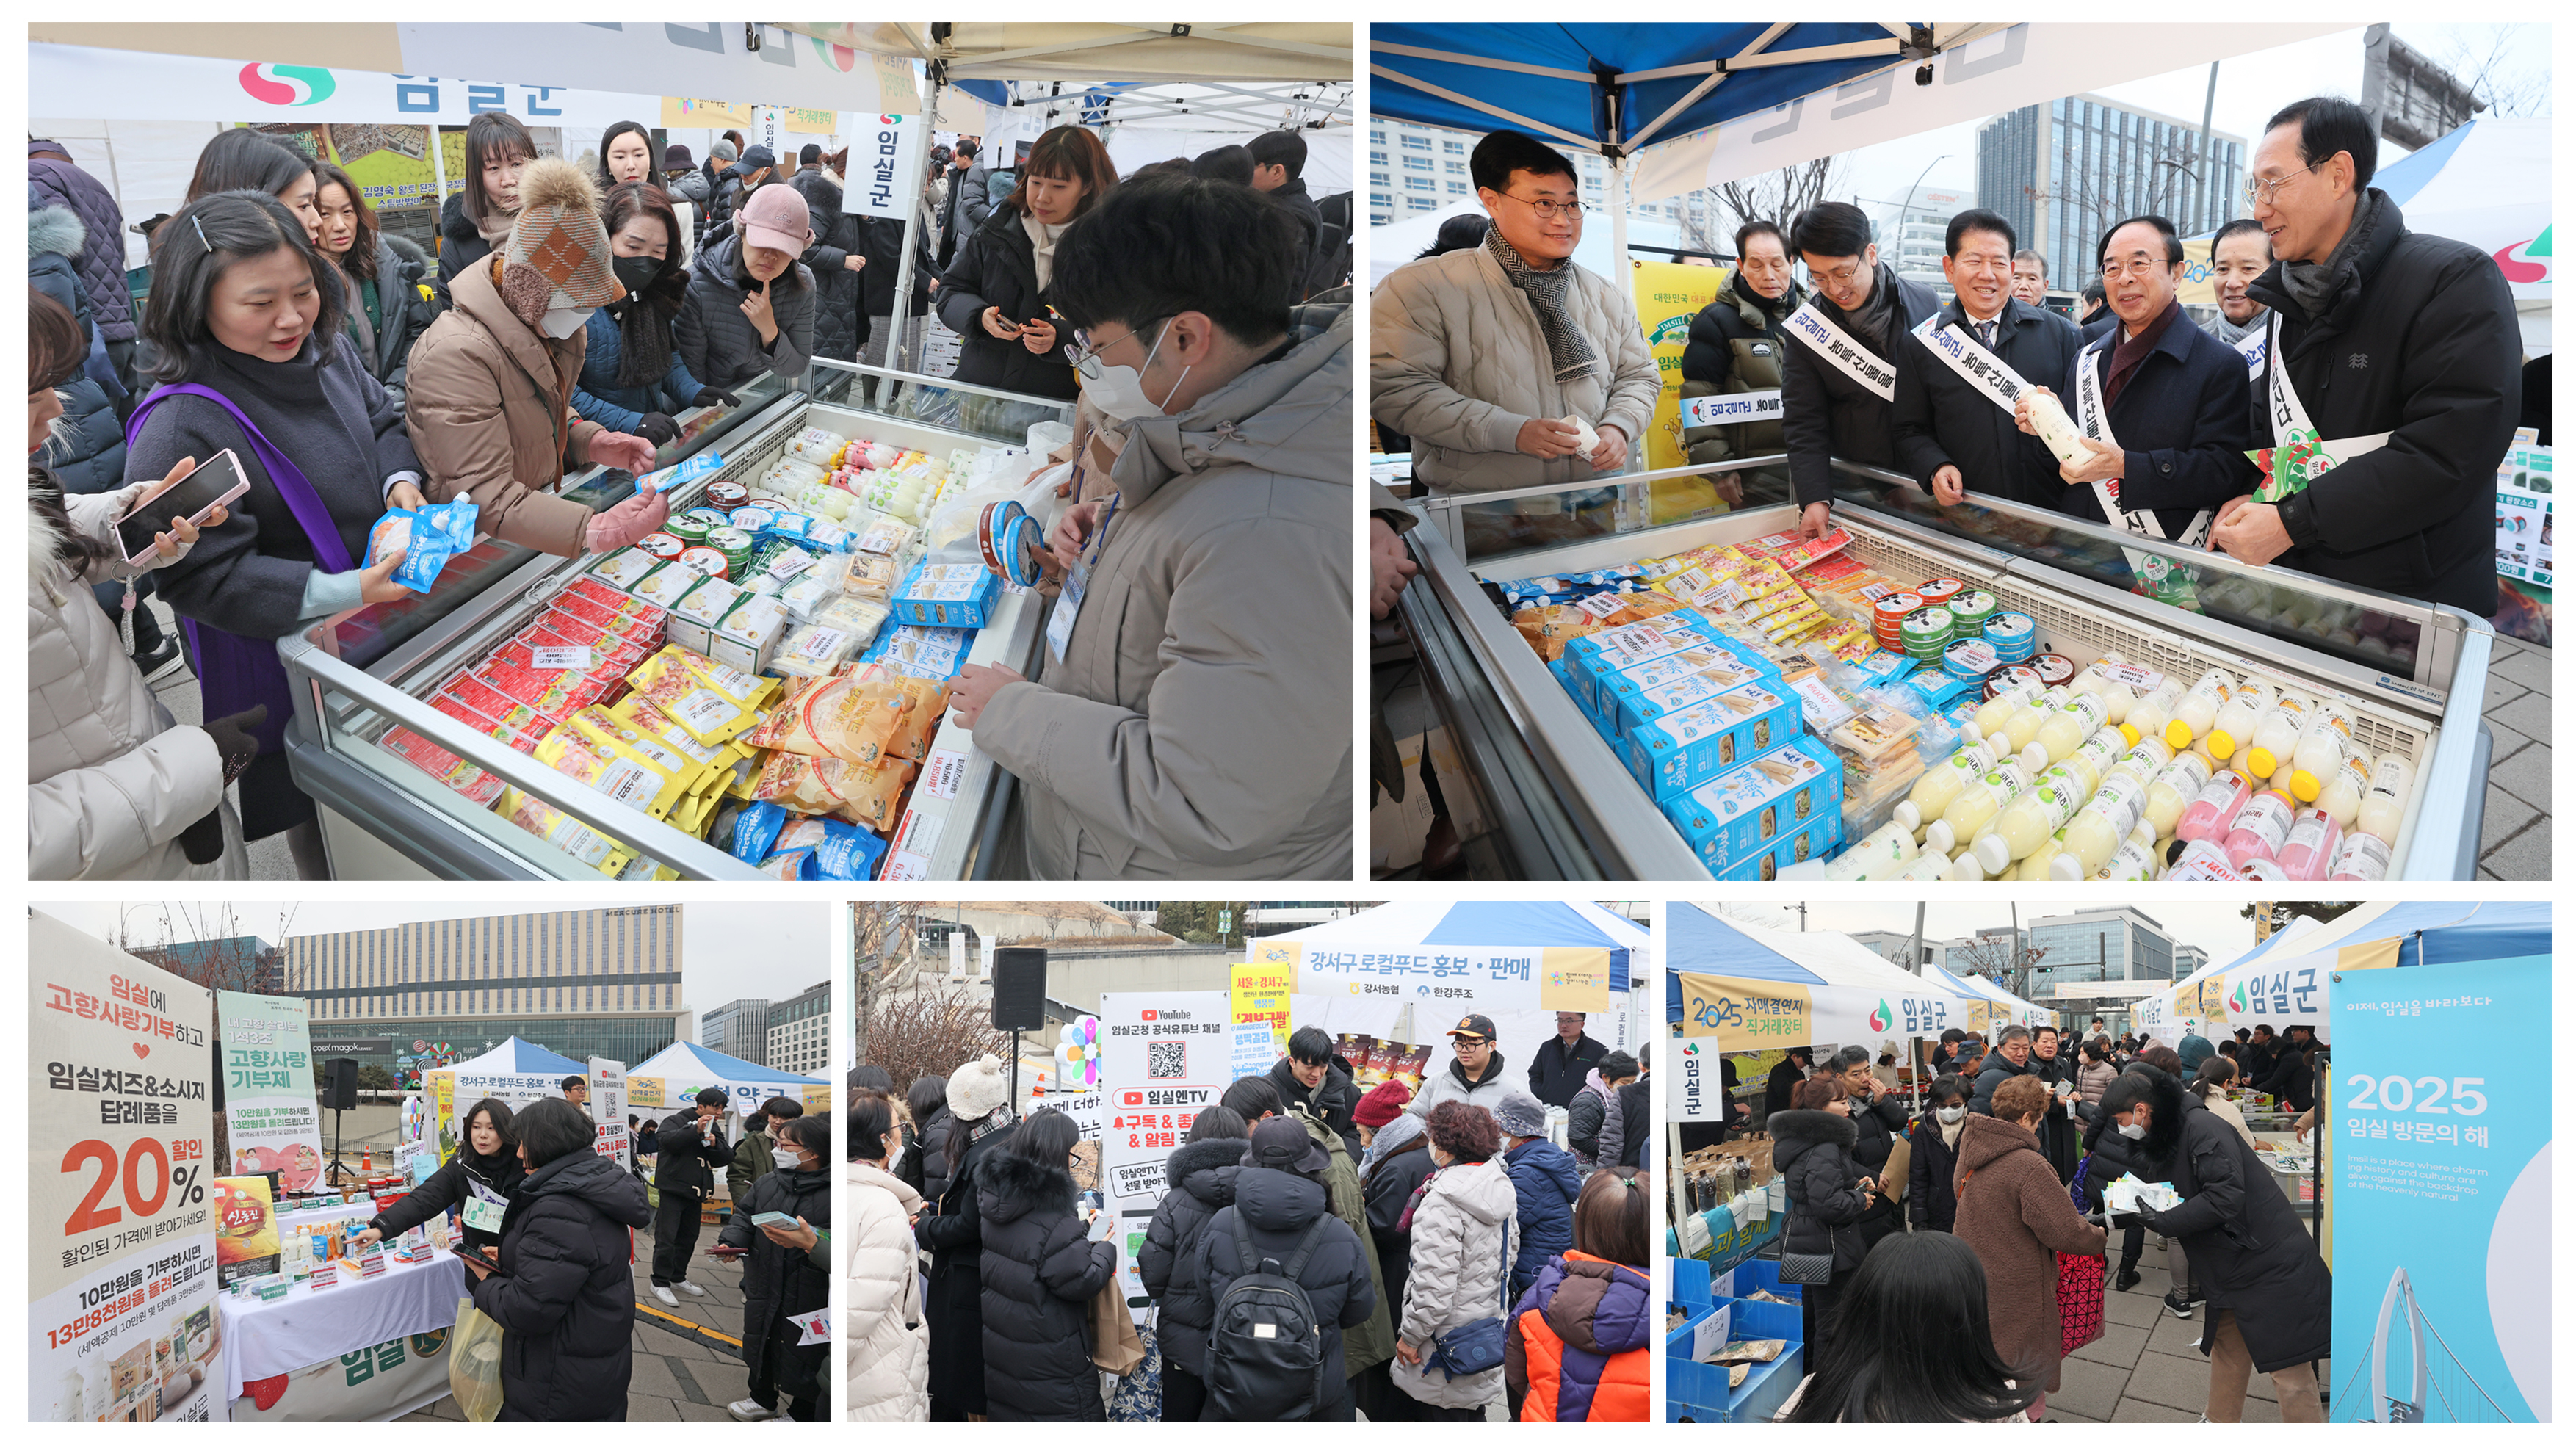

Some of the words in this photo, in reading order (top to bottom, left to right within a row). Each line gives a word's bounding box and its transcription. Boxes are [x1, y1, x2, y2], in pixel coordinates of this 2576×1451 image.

[797, 108, 832, 124] 직거래장터
[869, 130, 899, 209] 임실군
[363, 186, 395, 197] 김영숙
[398, 184, 416, 195] 황토
[1926, 192, 1959, 205] OSSTEM
[2184, 258, 2214, 285] 202
[1654, 292, 1688, 304] 대한민국
[1690, 294, 1707, 305] 대표
[1660, 316, 1683, 332] IMSIL
[1794, 311, 1831, 344] 임실군
[1828, 338, 1895, 388] 농특산물을
[1929, 326, 1964, 359] 임실군
[1657, 355, 1684, 372] 임실
[1710, 399, 1752, 417] 임실군
[2505, 496, 2536, 507] 된장소스
[2149, 564, 2166, 577] 임실군
[604, 908, 649, 918] MERCURE
[650, 905, 681, 916] HOTEL
[1265, 948, 1290, 962] 2025
[1310, 952, 1357, 974] 강서구
[1358, 953, 1430, 977] 로컬푸드
[1431, 955, 1472, 980] 홍보
[1488, 956, 1531, 982] 판매
[1237, 977, 1253, 989] 서울
[1363, 983, 1400, 996] 강서농협
[1433, 985, 1474, 999] 한강주조
[1589, 979, 1604, 987] 강서
[2249, 968, 2318, 1015] 임실군
[109, 974, 167, 1014] 임실에
[45, 982, 204, 1048] 고향사랑기부하고
[1691, 996, 1743, 1030] 2025
[1745, 996, 1803, 1016] 자매결연지
[1901, 998, 1947, 1032] 임실군
[2146, 998, 2163, 1024] 임실군
[2346, 1001, 2380, 1013] 이제,
[2380, 999, 2423, 1017] 임실을
[2425, 996, 2492, 1009] 바라보다
[227, 1017, 239, 1029] 내
[242, 1018, 265, 1030] 고향
[267, 1018, 299, 1032] 살리는
[1158, 1010, 1191, 1021] YouTube
[1111, 1024, 1150, 1036] 임실군청
[1151, 1023, 1200, 1035] 공식유튜브
[1201, 1023, 1221, 1034] 채널
[1745, 1018, 1803, 1037] 직거래장터
[228, 1030, 274, 1046] 1석3조
[1235, 1031, 1270, 1046] 생막걸리
[312, 1043, 332, 1053] coex
[332, 1042, 359, 1054] magok
[463, 1046, 479, 1054] HAPPY
[228, 1049, 307, 1068] 고향사랑
[46, 1060, 206, 1101] 임실치즈&소시지
[231, 1070, 292, 1090] 기부제
[460, 1076, 488, 1088] 강서구
[489, 1077, 526, 1088] 로컬푸드
[526, 1077, 546, 1089] 홍보
[1683, 1059, 1702, 1116] 임실군
[631, 1089, 662, 1097] 자매결연지
[1147, 1090, 1209, 1106] 임실엔TV
[2346, 1074, 2489, 1117] 2025
[100, 1100, 178, 1125] 답례품을
[235, 1107, 272, 1119] 10만원을
[272, 1106, 311, 1118] 기부하시면
[231, 1118, 267, 1130] 13만원을
[267, 1117, 316, 1129] 돌려드립니다!
[1126, 1114, 1157, 1130] 구독
[1161, 1114, 1173, 1129] &
[1128, 1133, 1140, 1148] &
[1144, 1132, 1176, 1148] 알림
[2346, 1118, 2389, 1140] 임실
[2392, 1120, 2459, 1146] 방문의
[2463, 1124, 2489, 1149] 해
[171, 1138, 203, 1162] 할인
[1118, 1165, 1158, 1180] 임실엔TV
[2348, 1154, 2369, 1162] Imsil
[2370, 1156, 2378, 1164] is
[2388, 1158, 2415, 1168] place
[2417, 1162, 2450, 1172] where
[2451, 1165, 2489, 1176] charm
[2348, 1163, 2362, 1173] ing
[2364, 1164, 2396, 1176] history
[2397, 1168, 2417, 1178] and
[2418, 1170, 2455, 1182] culture
[2456, 1176, 2477, 1185] are
[1124, 1181, 1142, 1192] 선물
[2348, 1172, 2370, 1181] alive
[2371, 1173, 2407, 1186] against
[2408, 1177, 2425, 1188] the
[2426, 1180, 2479, 1197] backdrop
[2348, 1181, 2357, 1189] of
[2358, 1182, 2374, 1190] the
[2375, 1184, 2420, 1198] heavenly
[2420, 1190, 2459, 1202] natural
[227, 1208, 260, 1226] 신동진
[62, 1237, 110, 1270] 할인된
[113, 1226, 153, 1251] 가격에
[154, 1209, 207, 1234] 받아가세요!
[79, 1268, 144, 1311] 10만원을
[146, 1244, 202, 1281] 기부하시면
[46, 1286, 146, 1350] 13만8천원을
[148, 1254, 214, 1301] 돌려드립니다!
[76, 1325, 119, 1358] (세액공제
[120, 1311, 148, 1334] 10만원
[148, 1305, 156, 1319] 및
[156, 1294, 178, 1315] 답례품
[178, 1278, 206, 1302] 3만8천원)
